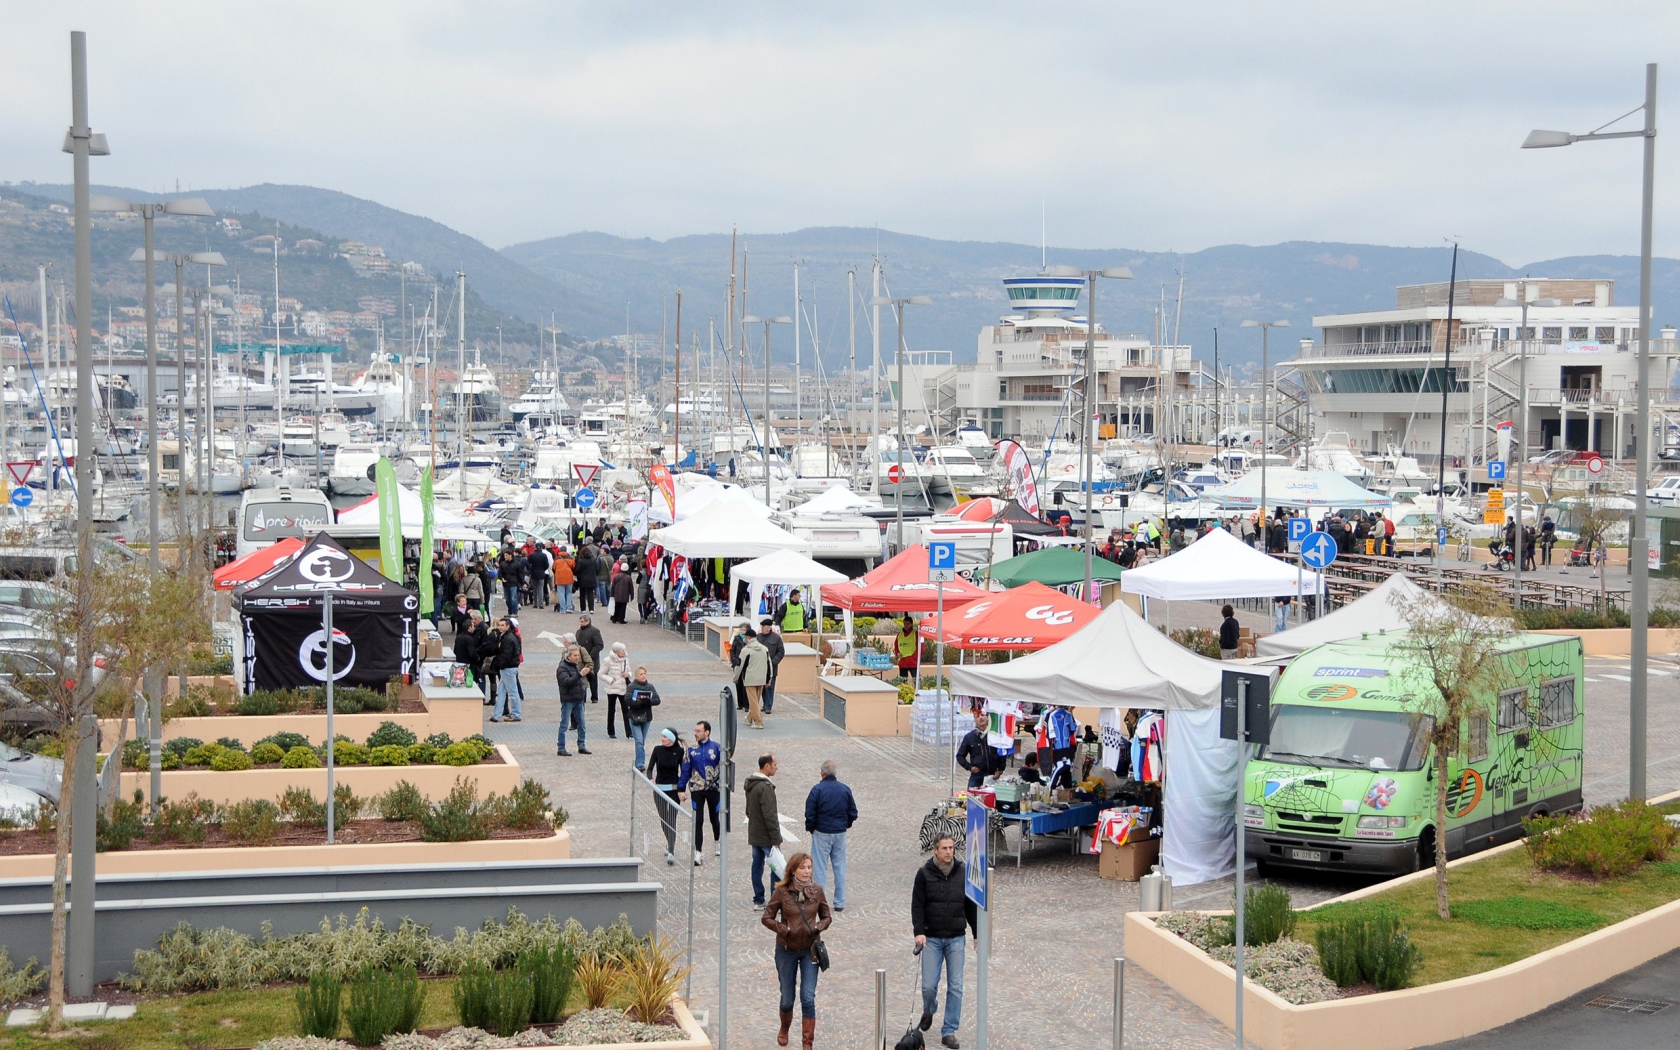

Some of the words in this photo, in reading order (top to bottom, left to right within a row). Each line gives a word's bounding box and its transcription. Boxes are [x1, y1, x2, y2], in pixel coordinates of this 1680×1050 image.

[1492, 464, 1501, 477] P
[1292, 521, 1306, 539] P
[1440, 529, 1445, 544] P
[934, 545, 950, 566] P
[244, 598, 309, 607] HERSH
[1316, 668, 1361, 677] sprint
